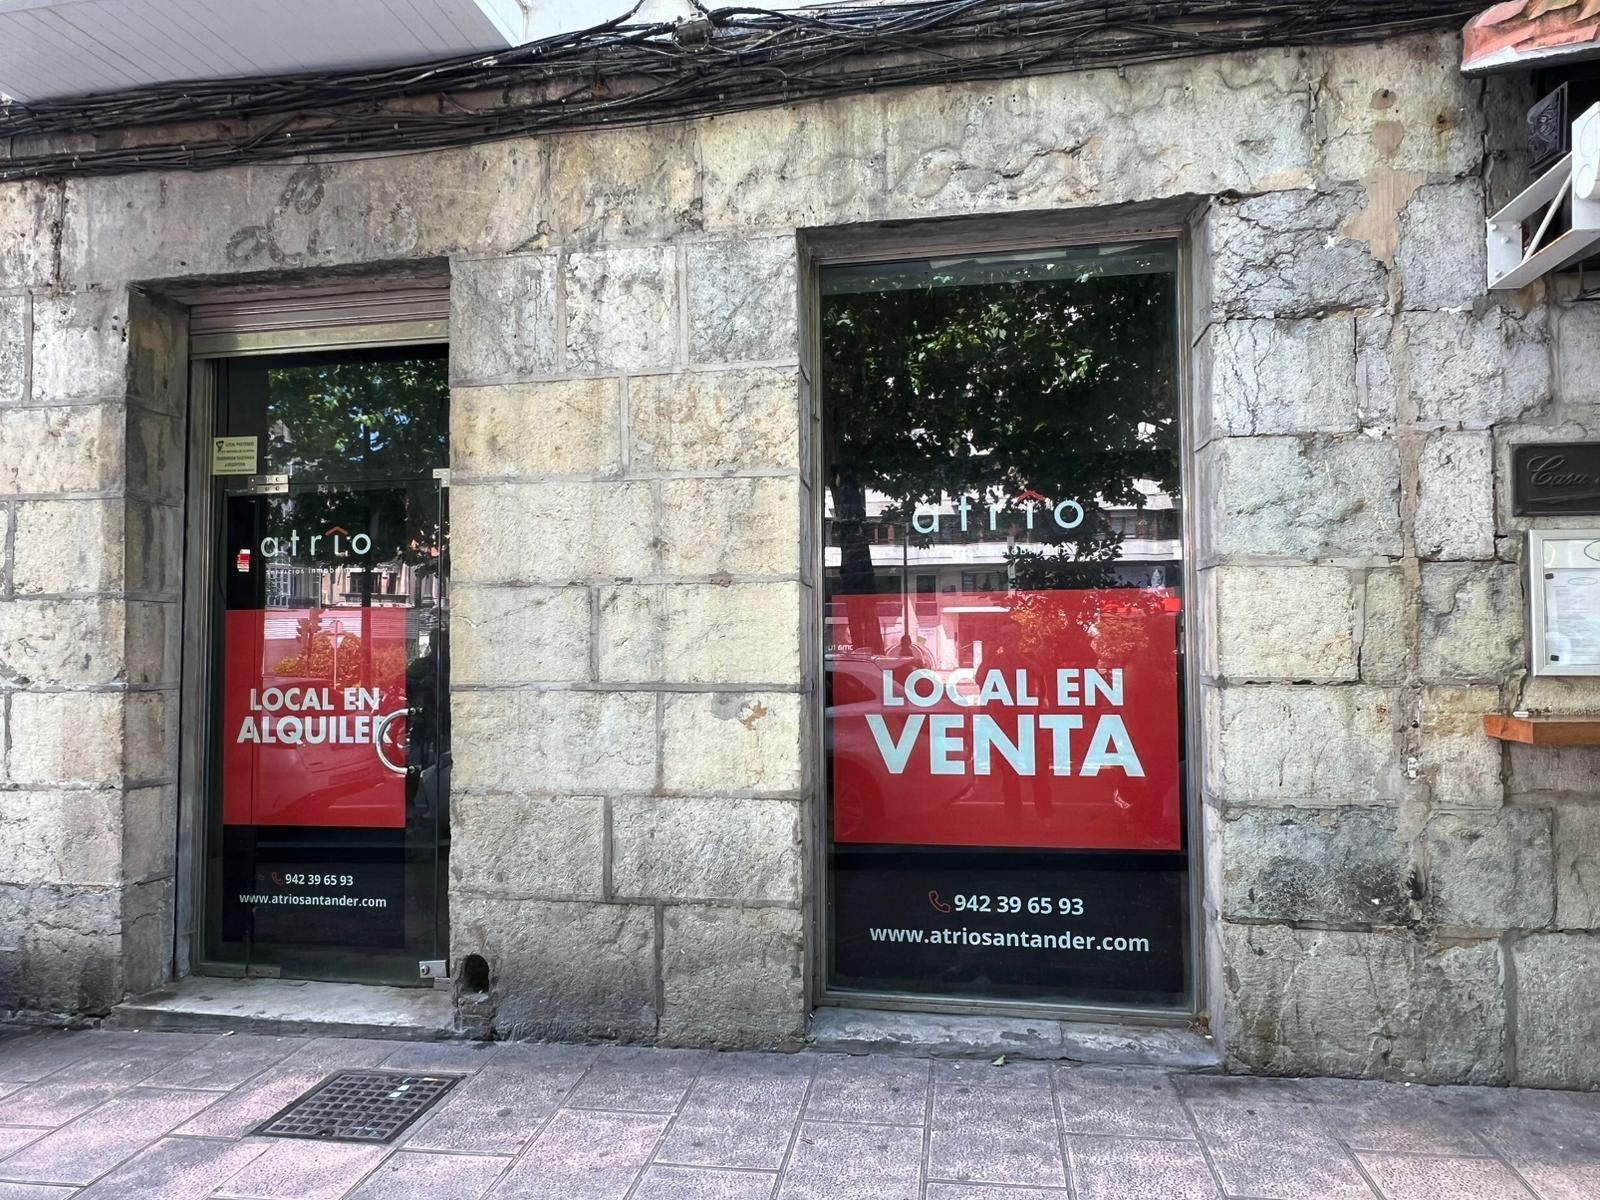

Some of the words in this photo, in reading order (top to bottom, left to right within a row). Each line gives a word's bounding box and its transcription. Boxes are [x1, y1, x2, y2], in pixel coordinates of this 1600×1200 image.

[250, 687, 334, 711] LOCAL
[343, 687, 380, 711] EN
[882, 668, 1039, 708] LOCAL
[1056, 668, 1124, 707] EN
[864, 713, 1146, 777] VENTA
[285, 873, 305, 885] 942
[307, 874, 321, 885] 39
[323, 874, 337, 886] 65
[340, 875, 354, 886] 93
[239, 893, 387, 907] www.atriosantander.com
[954, 894, 991, 912] 942
[997, 895, 1022, 913] 39
[1027, 896, 1052, 914] 65
[1058, 898, 1084, 915] 93
[870, 927, 1150, 951] www.atriosantander.com
